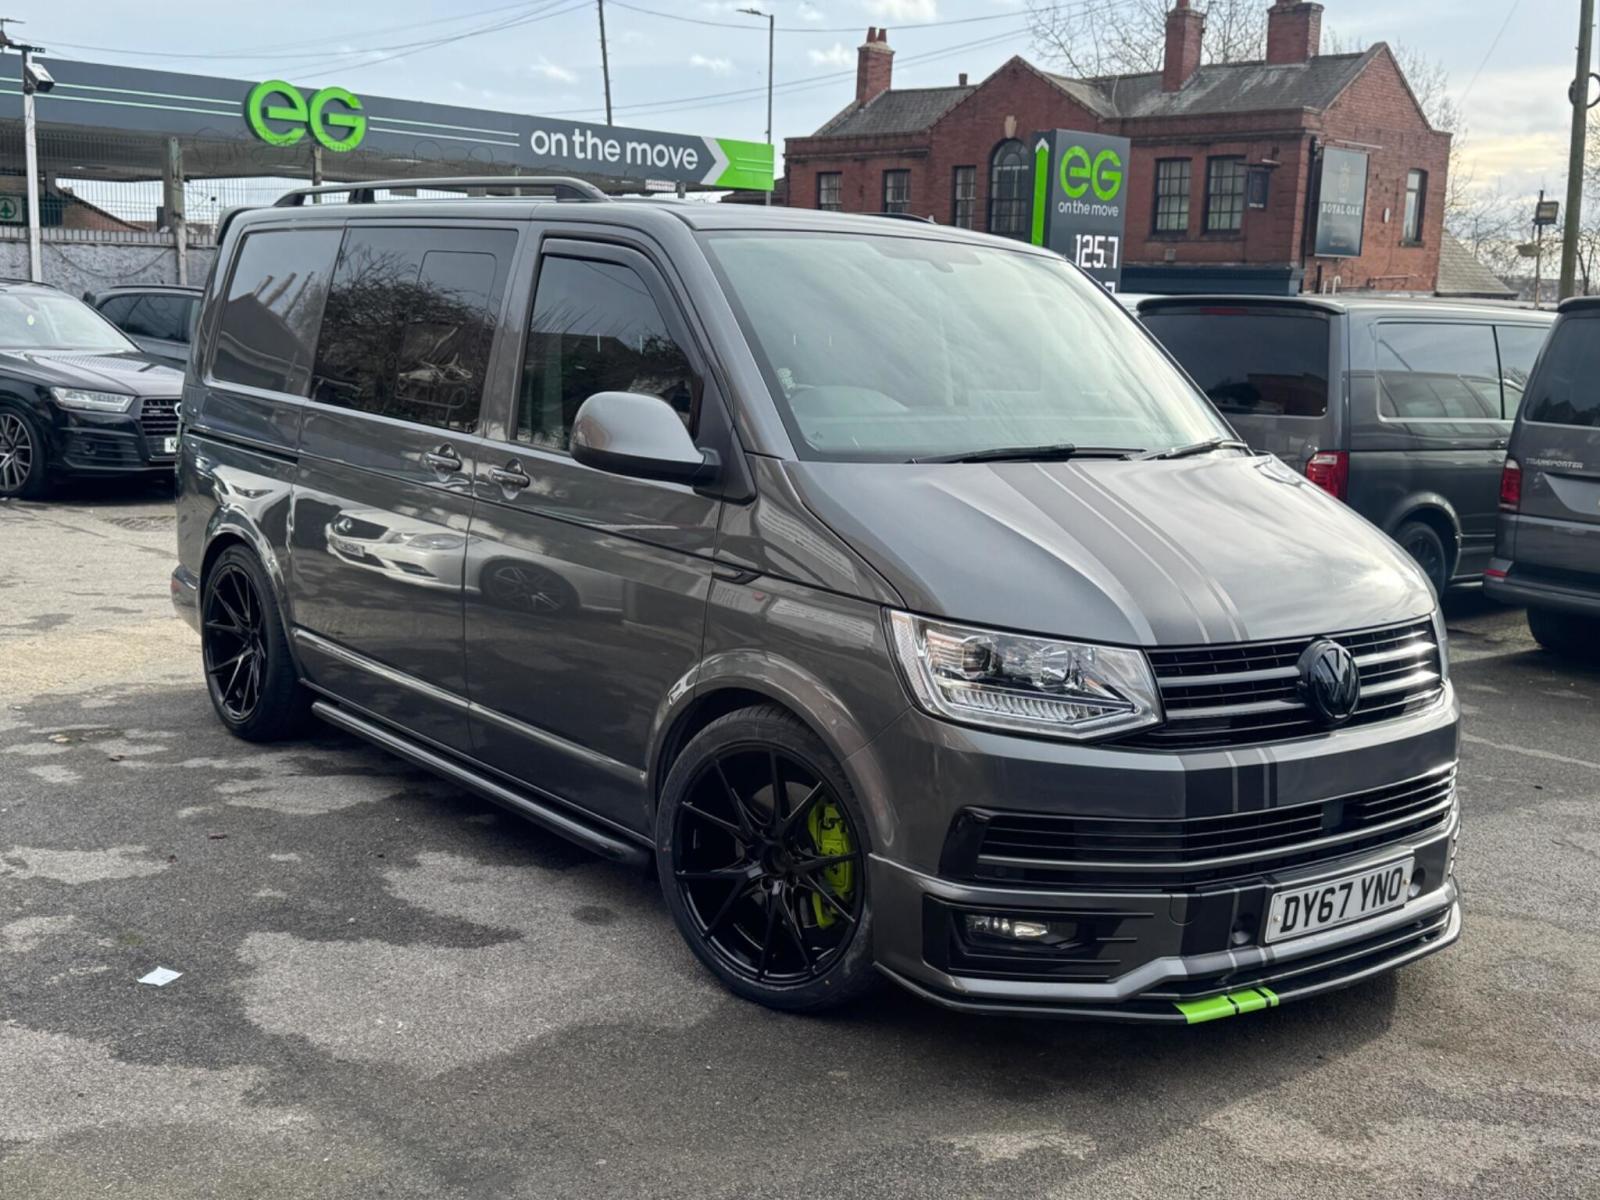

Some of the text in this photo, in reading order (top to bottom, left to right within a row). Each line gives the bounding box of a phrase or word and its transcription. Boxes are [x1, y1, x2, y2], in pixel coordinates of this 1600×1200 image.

[530, 128, 699, 170] on the move
[1058, 200, 1119, 217] on the move
[1075, 234, 1119, 269] 125.7
[1525, 458, 1583, 469] TRANSPORTER
[1280, 867, 1403, 933] DY67 YNO
